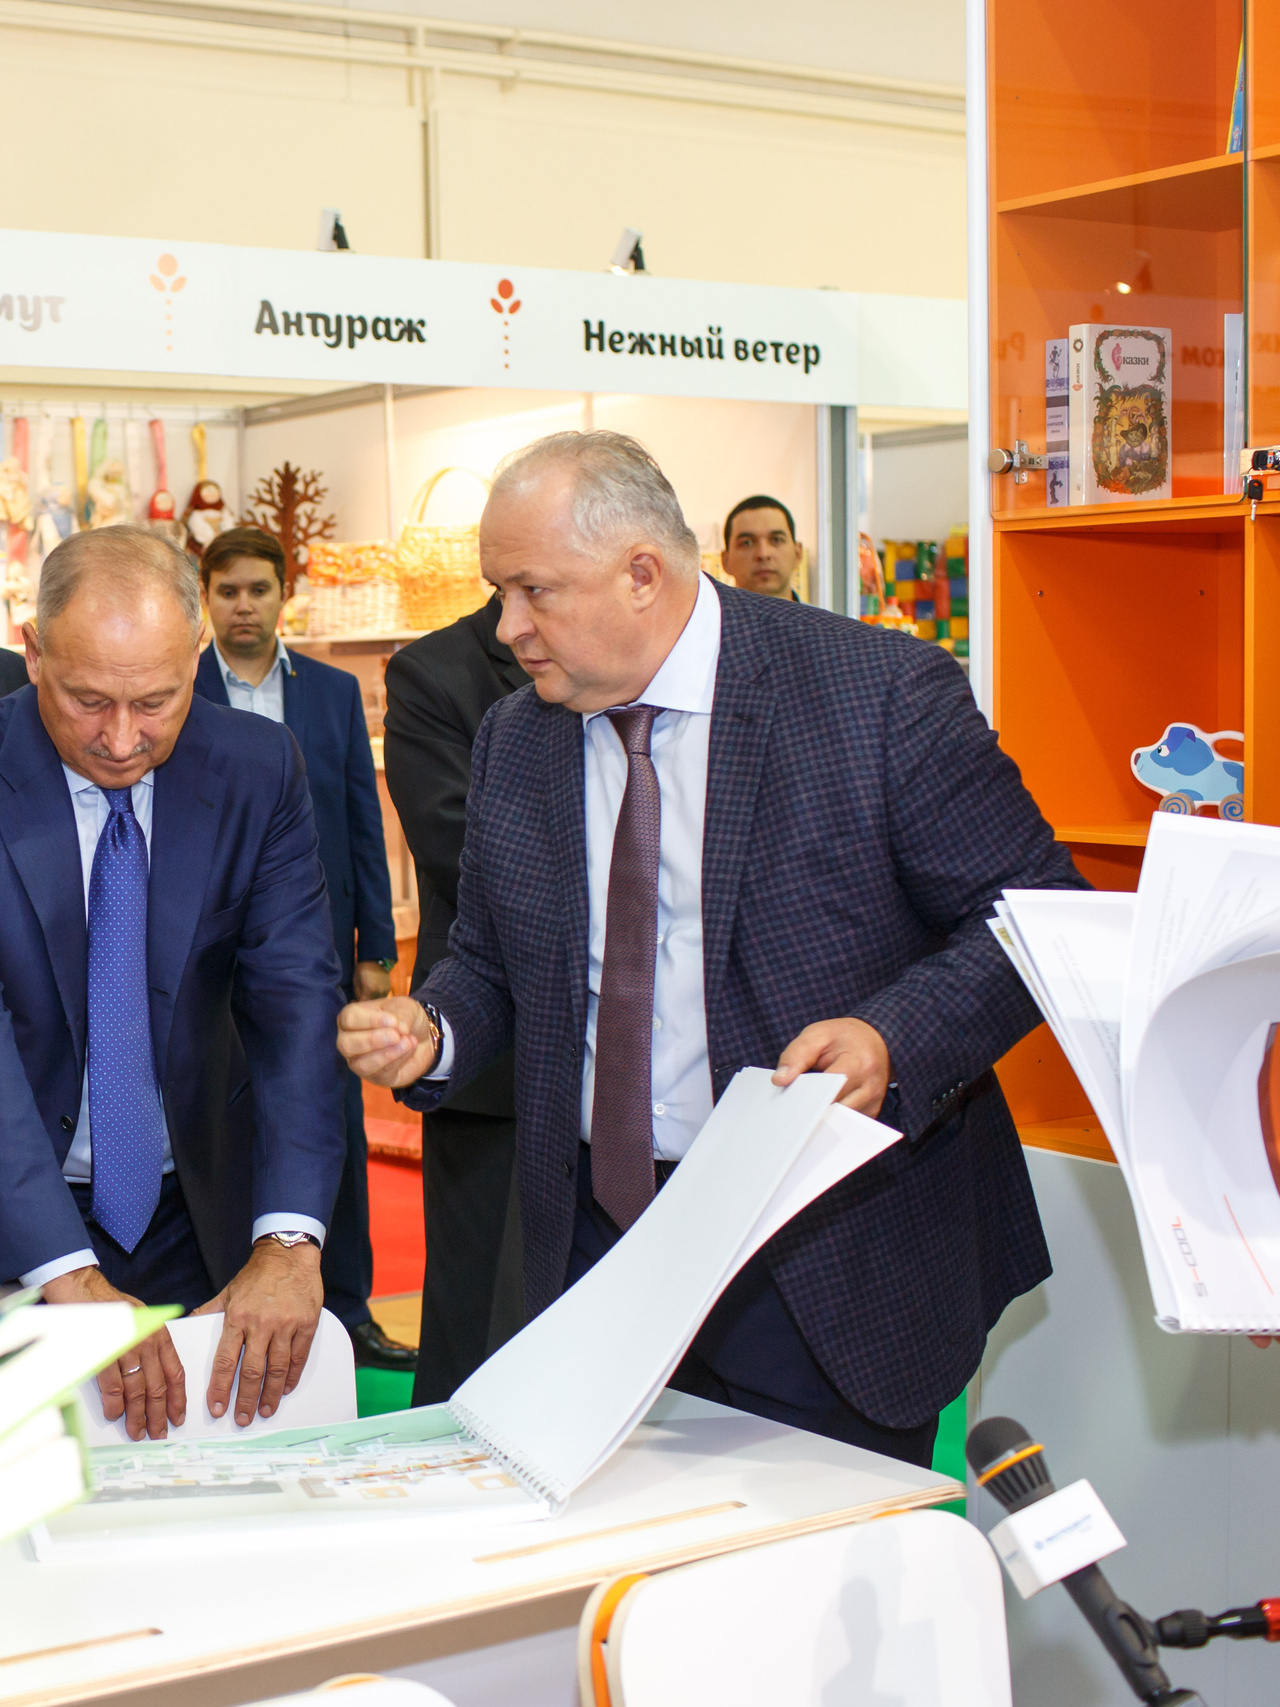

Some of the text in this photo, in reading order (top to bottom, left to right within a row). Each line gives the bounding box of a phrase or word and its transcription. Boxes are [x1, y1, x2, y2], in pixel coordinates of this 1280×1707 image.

[254, 299, 427, 350] Антураж
[582, 318, 822, 375] Нежный ветер
[1111, 342, 1150, 372] Сказки
